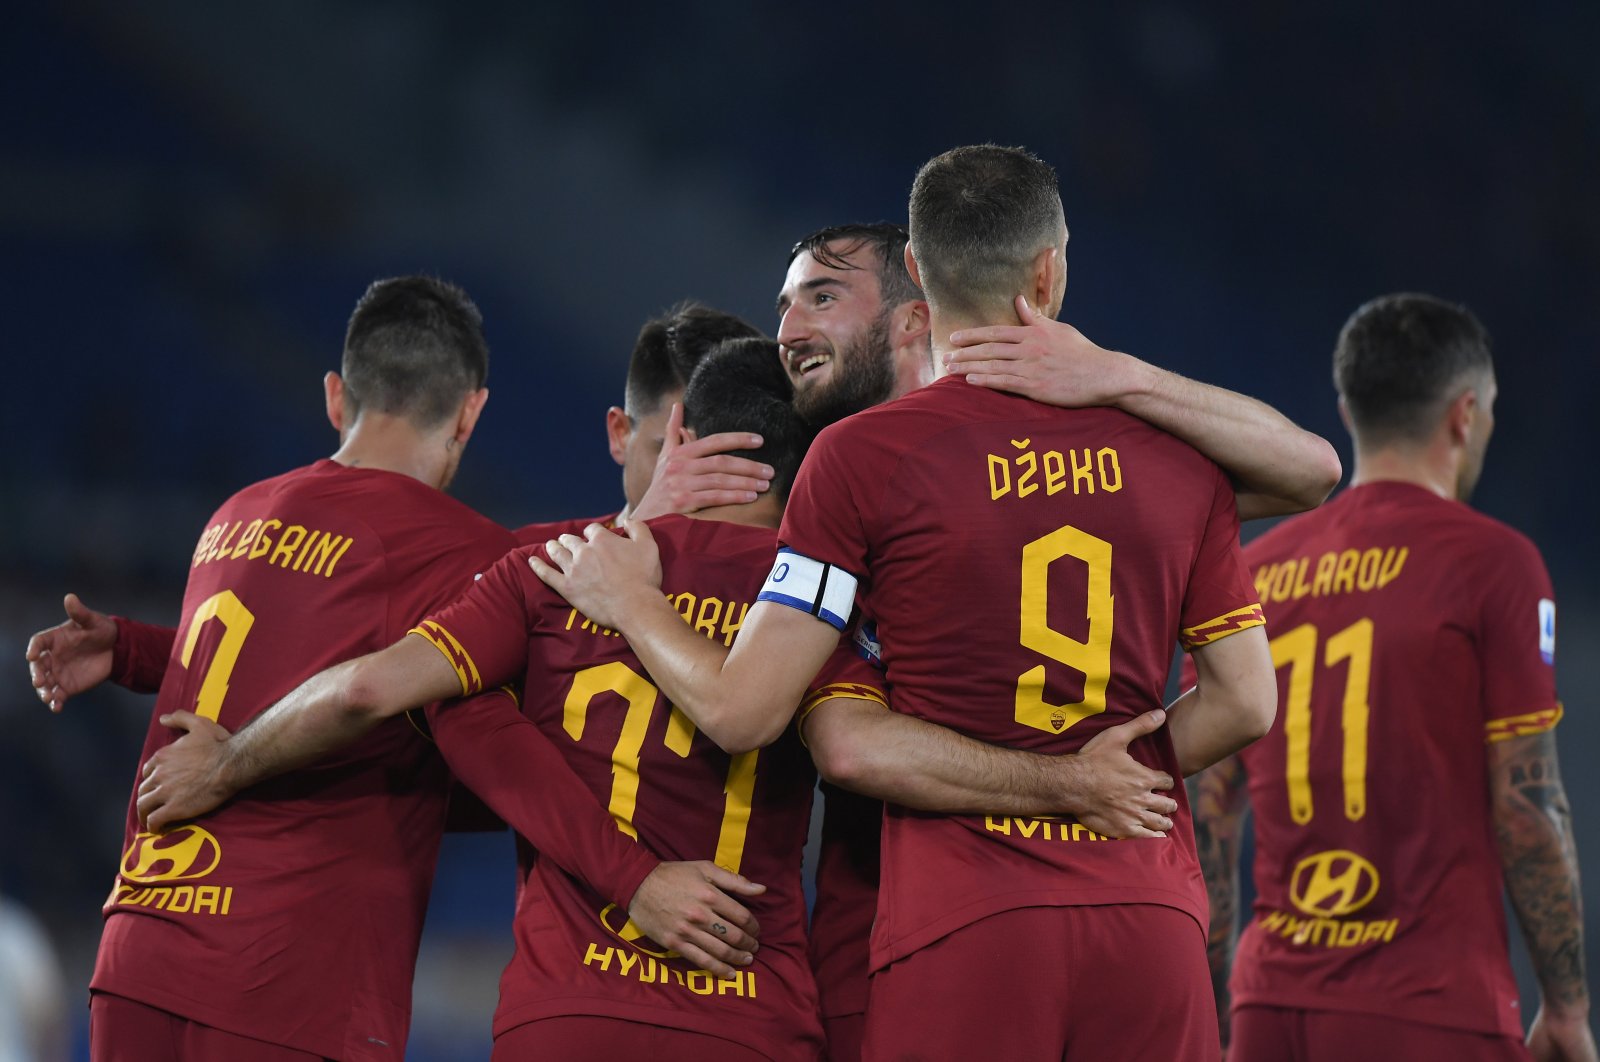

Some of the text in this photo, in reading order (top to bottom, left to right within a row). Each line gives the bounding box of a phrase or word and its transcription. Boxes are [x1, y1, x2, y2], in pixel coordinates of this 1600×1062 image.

[1014, 524, 1115, 735] 9
[1253, 546, 1409, 604] KOLAROV
[180, 589, 256, 723] 7
[1269, 617, 1374, 825] 11
[1259, 911, 1400, 948] HYUNDAI
